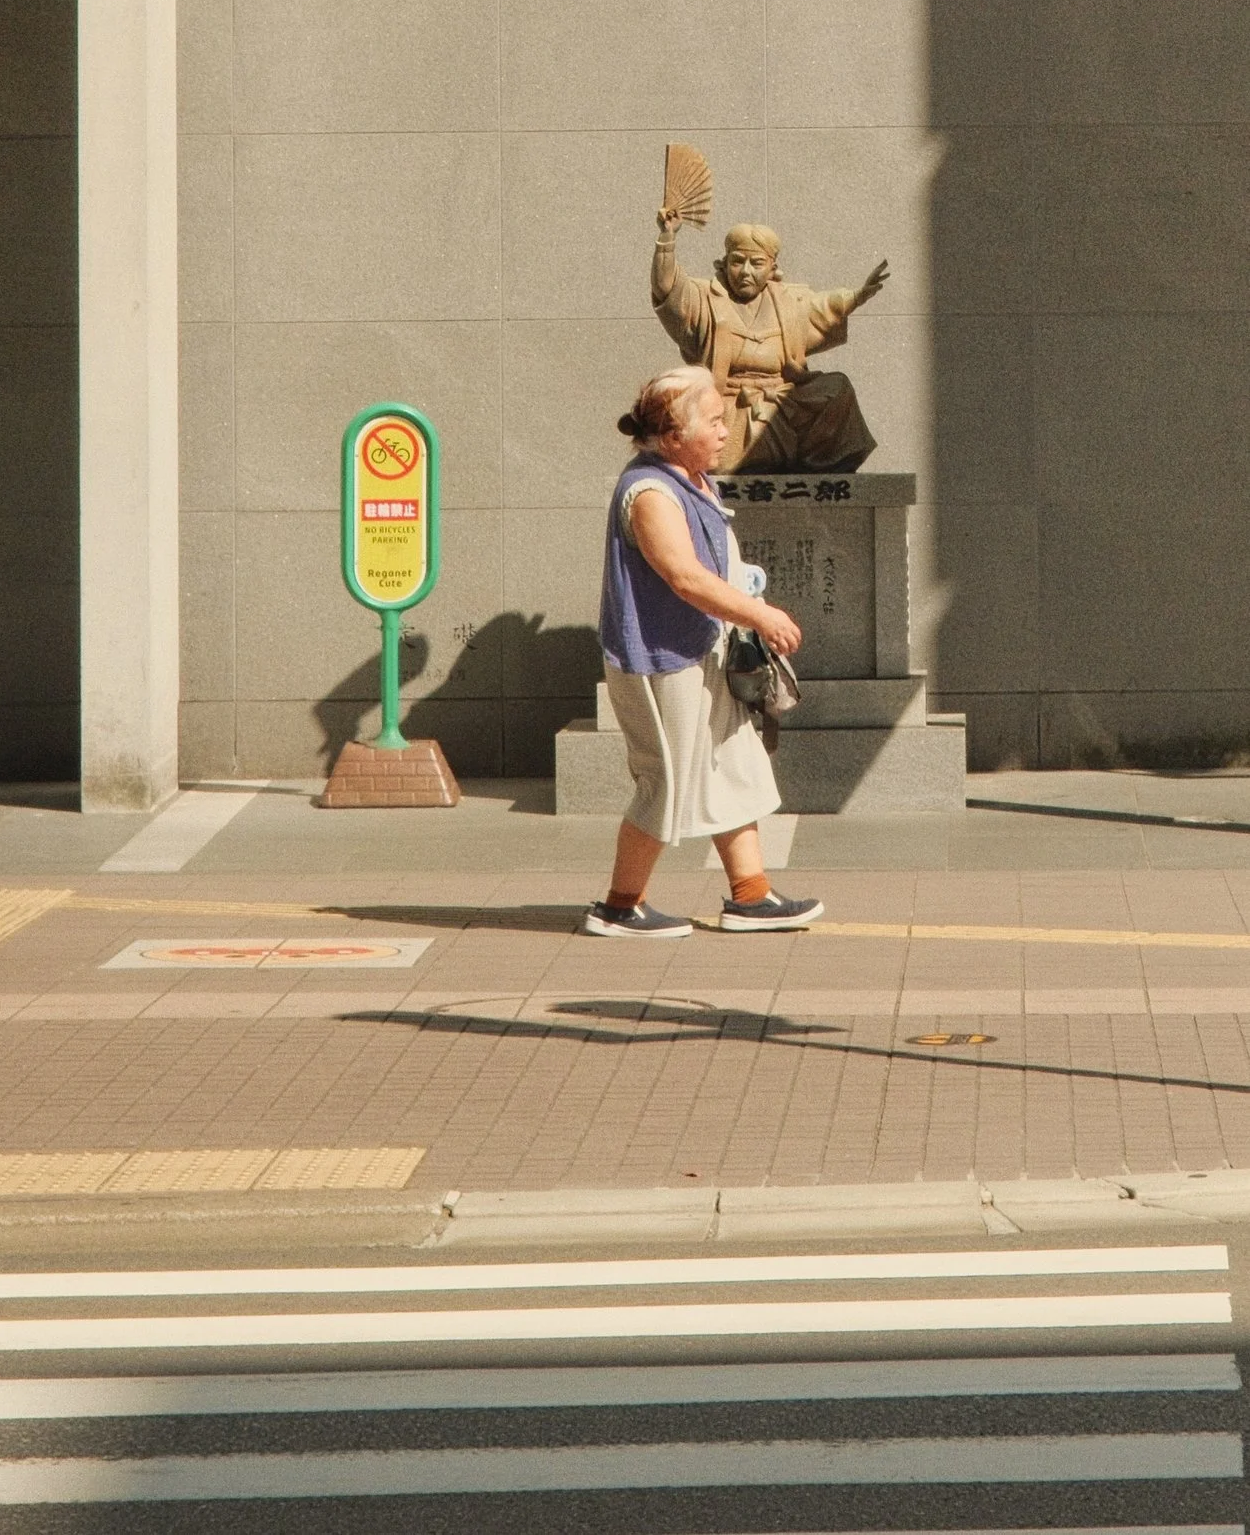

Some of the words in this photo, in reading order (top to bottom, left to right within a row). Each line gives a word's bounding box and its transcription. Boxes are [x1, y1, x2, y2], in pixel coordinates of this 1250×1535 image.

[364, 502, 416, 518] 駐輪禁止
[364, 526, 378, 534] NO
[379, 526, 416, 534] BICYCLES
[371, 536, 409, 544] PARKING
[367, 568, 412, 579] Reganet
[378, 579, 403, 588] Cute
